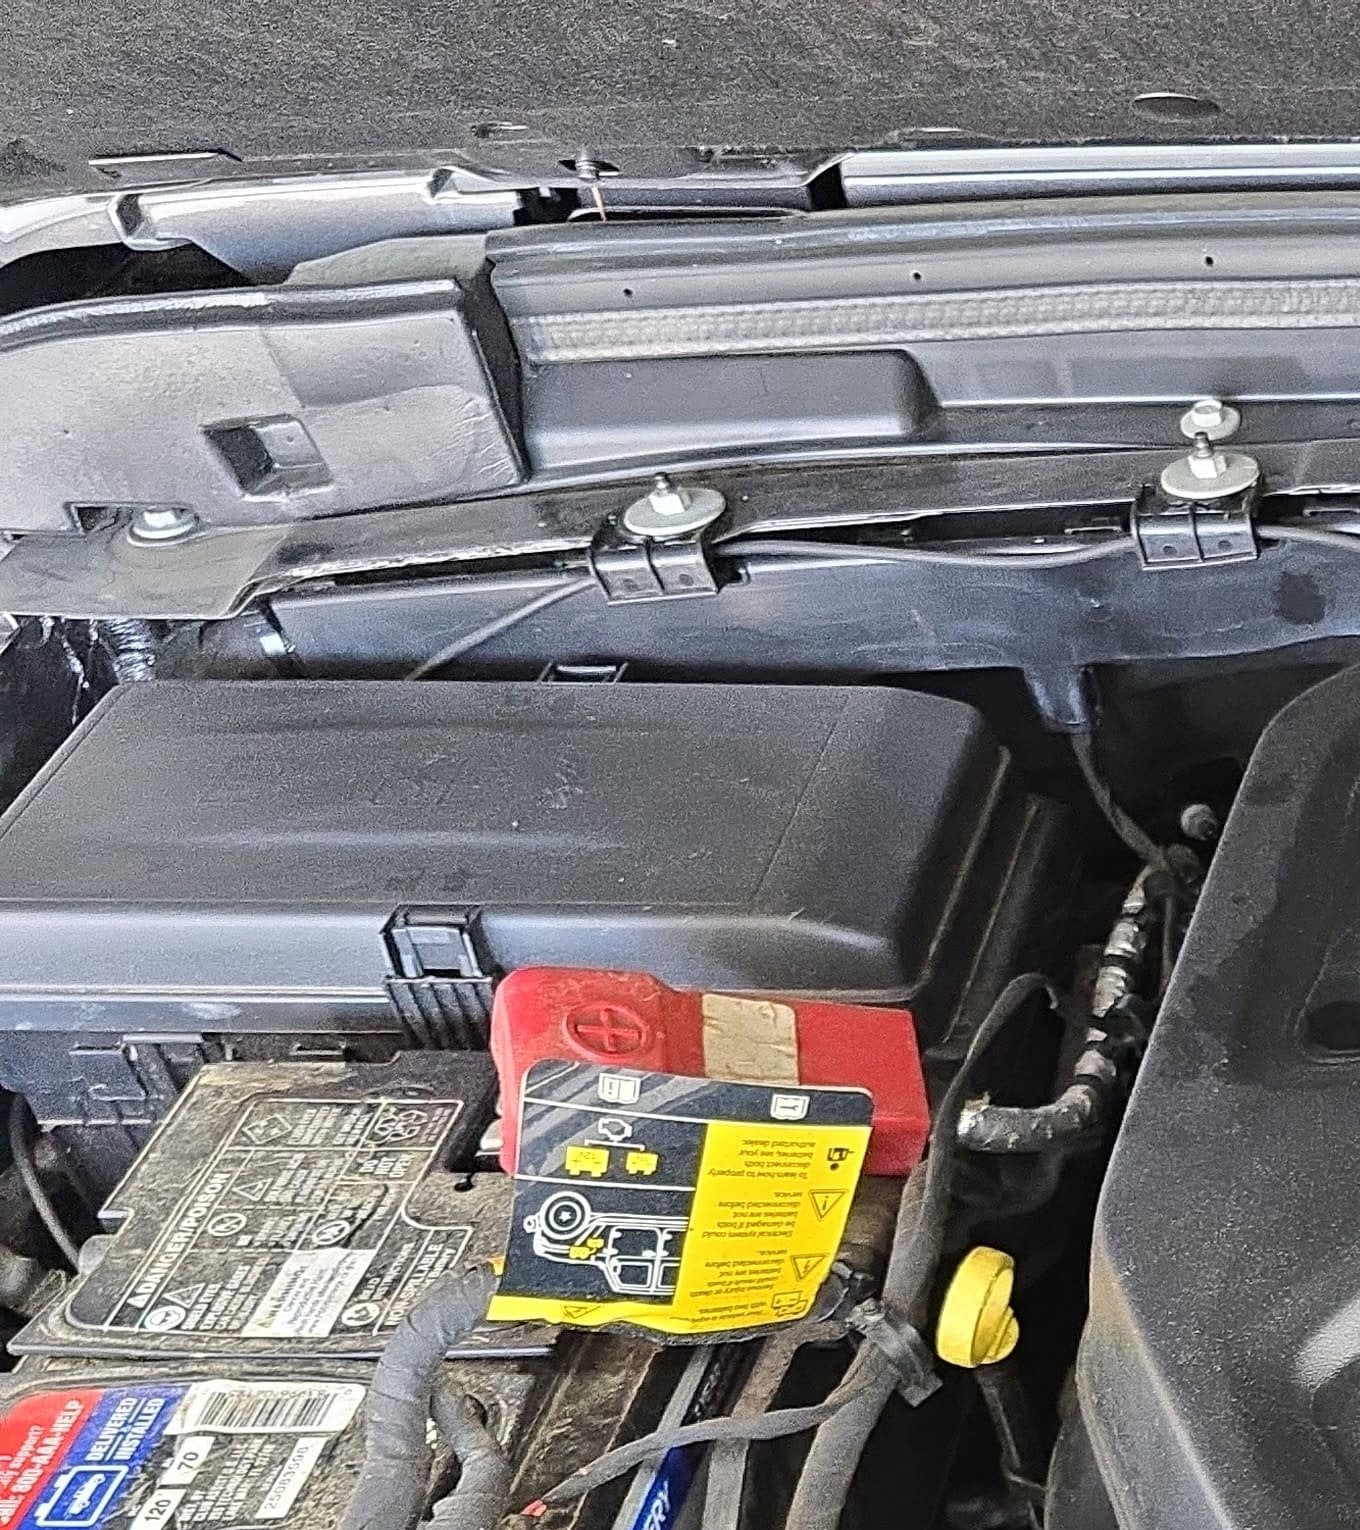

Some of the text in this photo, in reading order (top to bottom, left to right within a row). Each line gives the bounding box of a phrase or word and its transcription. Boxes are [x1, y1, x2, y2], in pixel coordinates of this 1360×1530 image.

[5, 1424, 50, 1469] support?
[10, 1398, 90, 1493] 800-AAA-HELP
[82, 1396, 141, 1461] DELIVERED
[110, 1396, 168, 1460] INSTALLED
[173, 1450, 203, 1471] 70
[140, 1497, 175, 1522] 120
